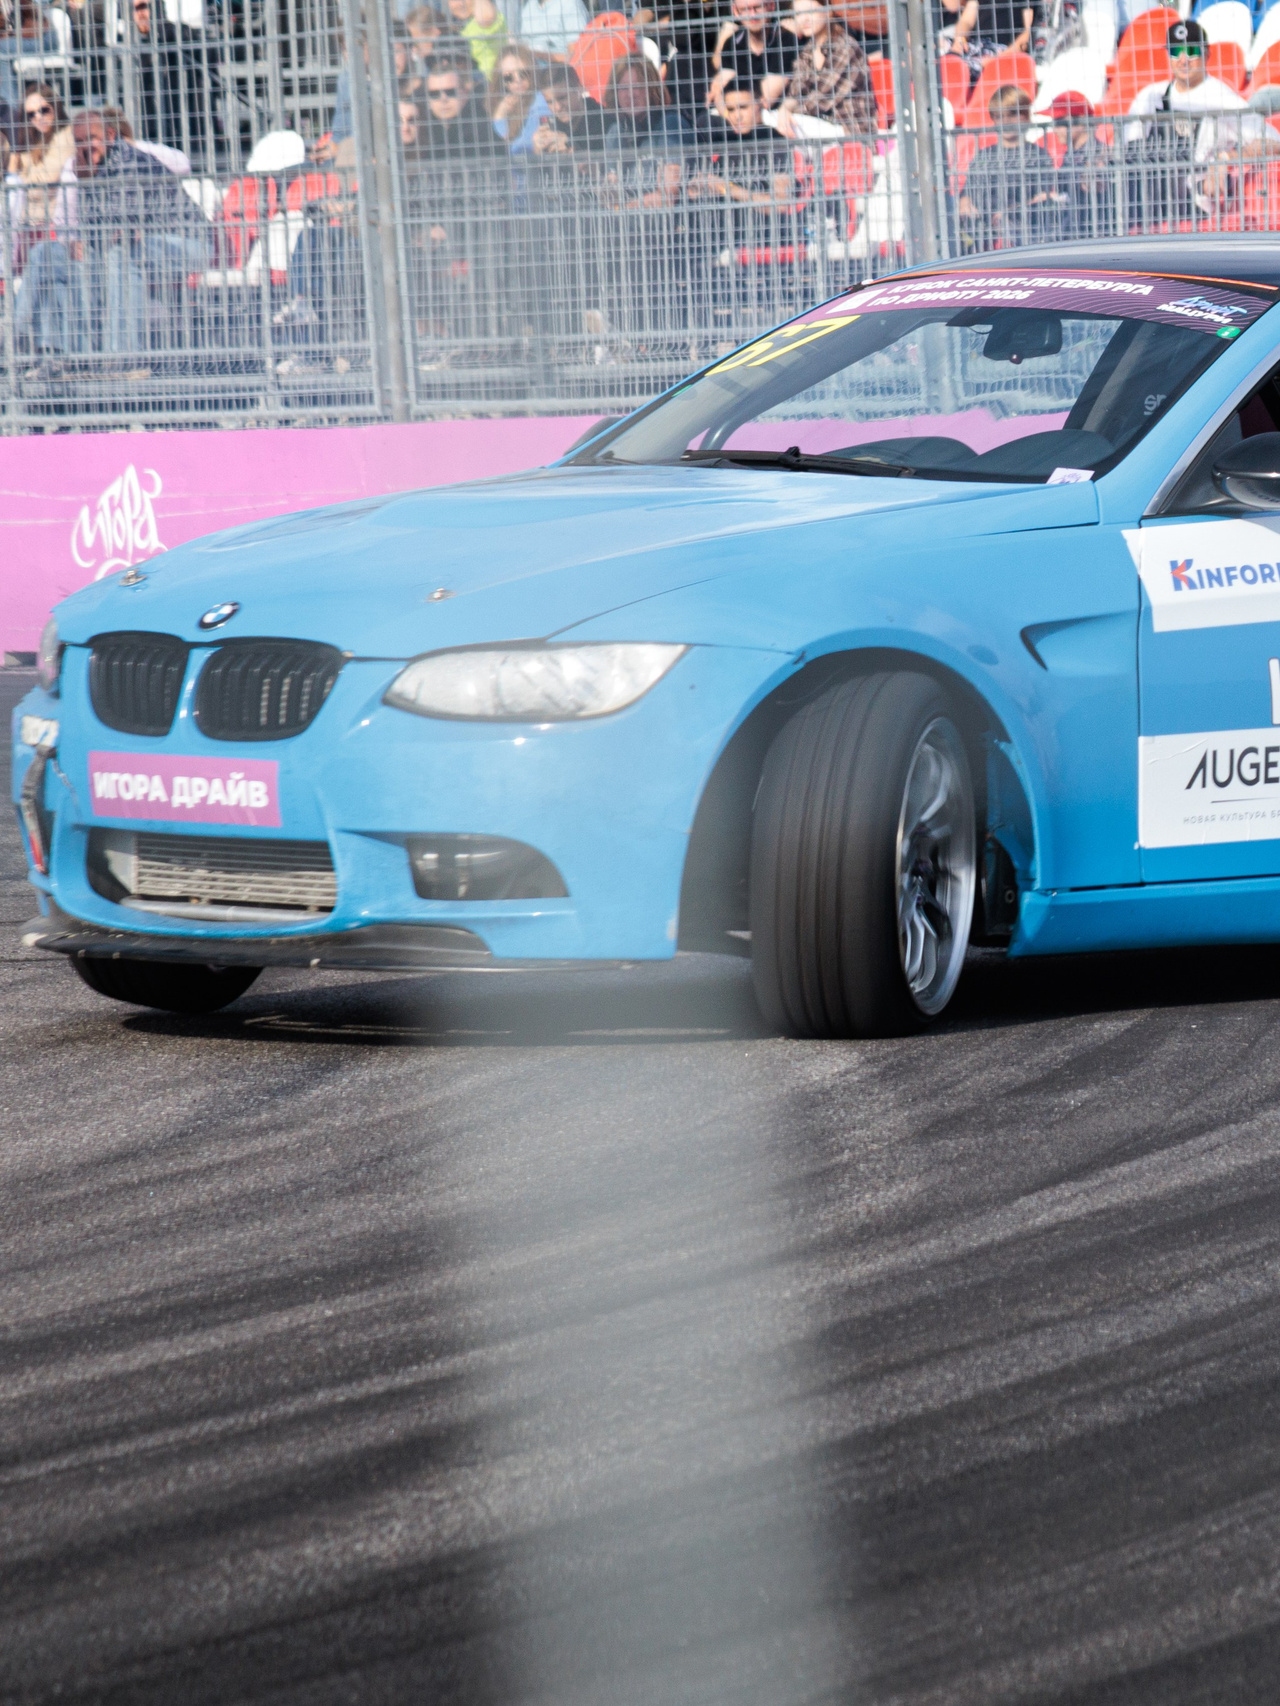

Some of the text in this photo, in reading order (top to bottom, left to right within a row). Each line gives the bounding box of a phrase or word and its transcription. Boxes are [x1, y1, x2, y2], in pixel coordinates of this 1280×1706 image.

[886, 277, 1155, 296] КУБОК САНКТ-ПЕТЕРБУРГА
[866, 295, 901, 307] ПО
[893, 290, 988, 305] ДРИФТУ
[704, 314, 861, 376] 67
[92, 771, 270, 809] ИГОРА ДРАЙВ
[1183, 814, 1217, 825] НОВАЯ
[1219, 810, 1268, 822] КУЛЬТУРА
